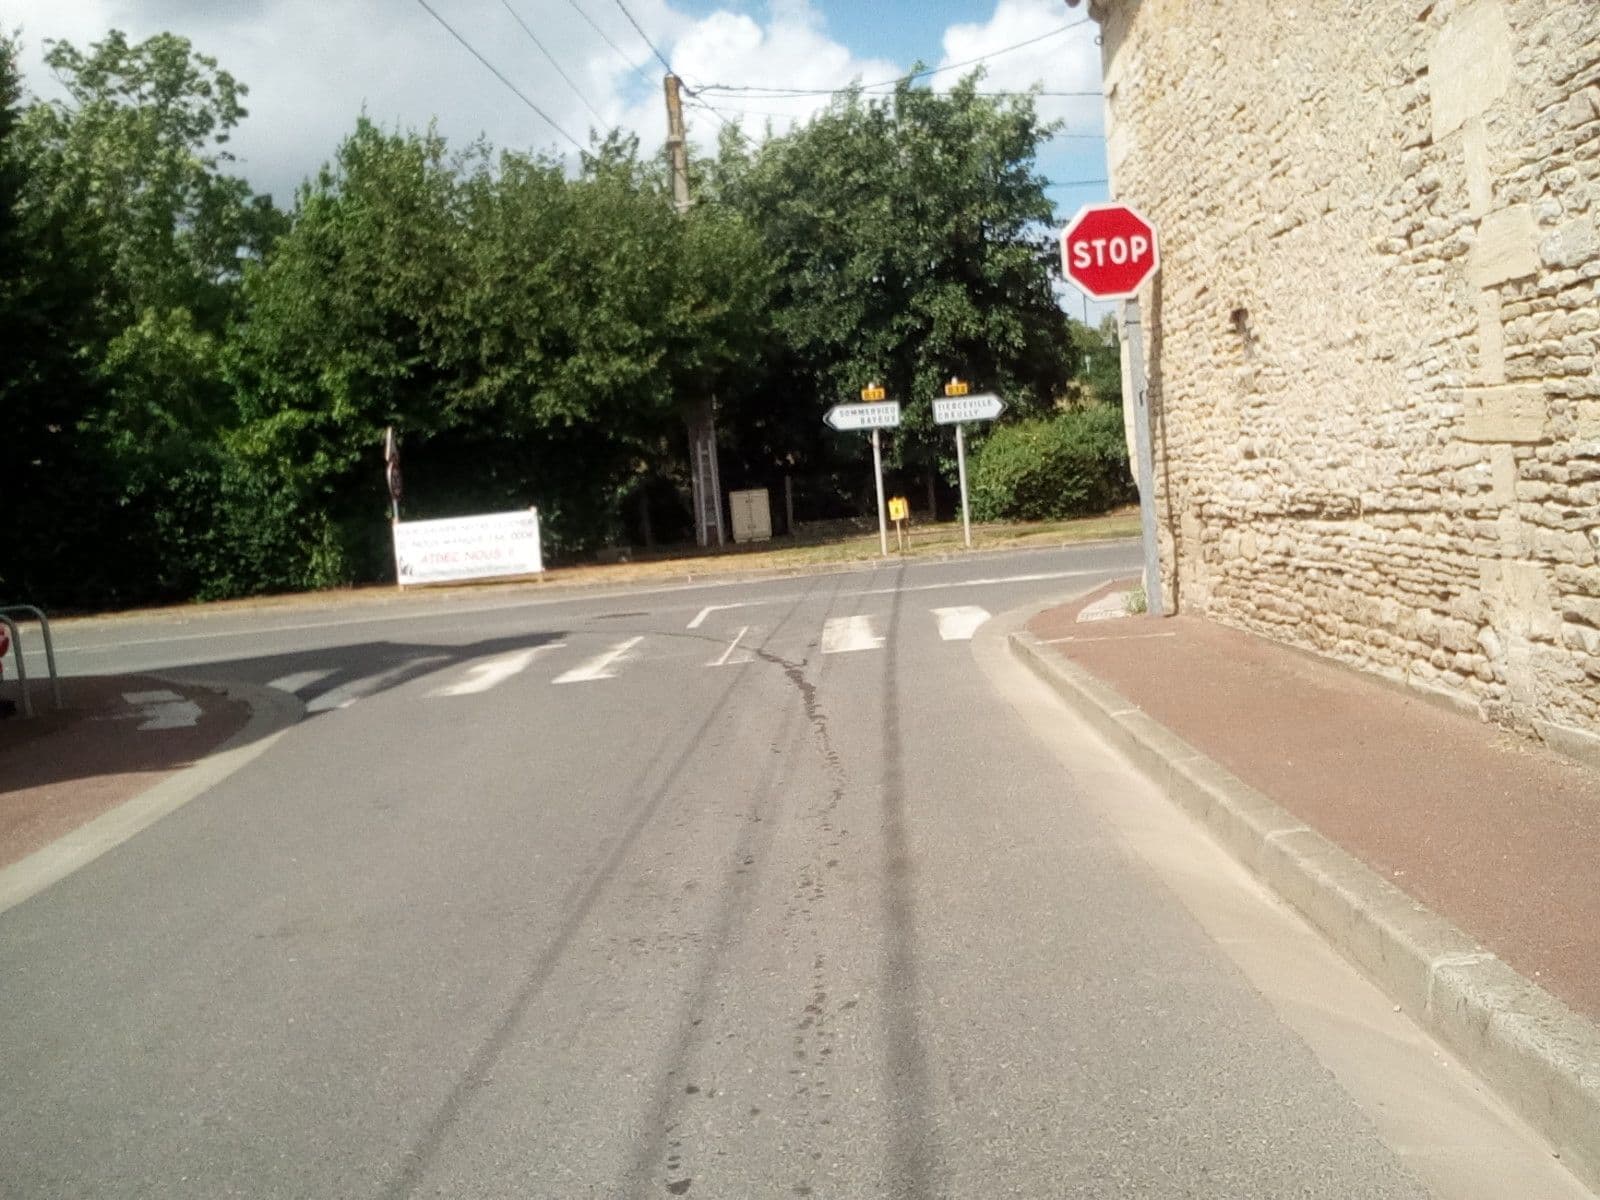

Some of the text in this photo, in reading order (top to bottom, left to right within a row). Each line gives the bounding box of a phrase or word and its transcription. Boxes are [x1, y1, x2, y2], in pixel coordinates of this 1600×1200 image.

[1073, 235, 1148, 269] STOP
[938, 399, 992, 411] TIERCEVILLE
[839, 406, 896, 417] SOMMERVIEU
[861, 415, 896, 425] BAYEUX
